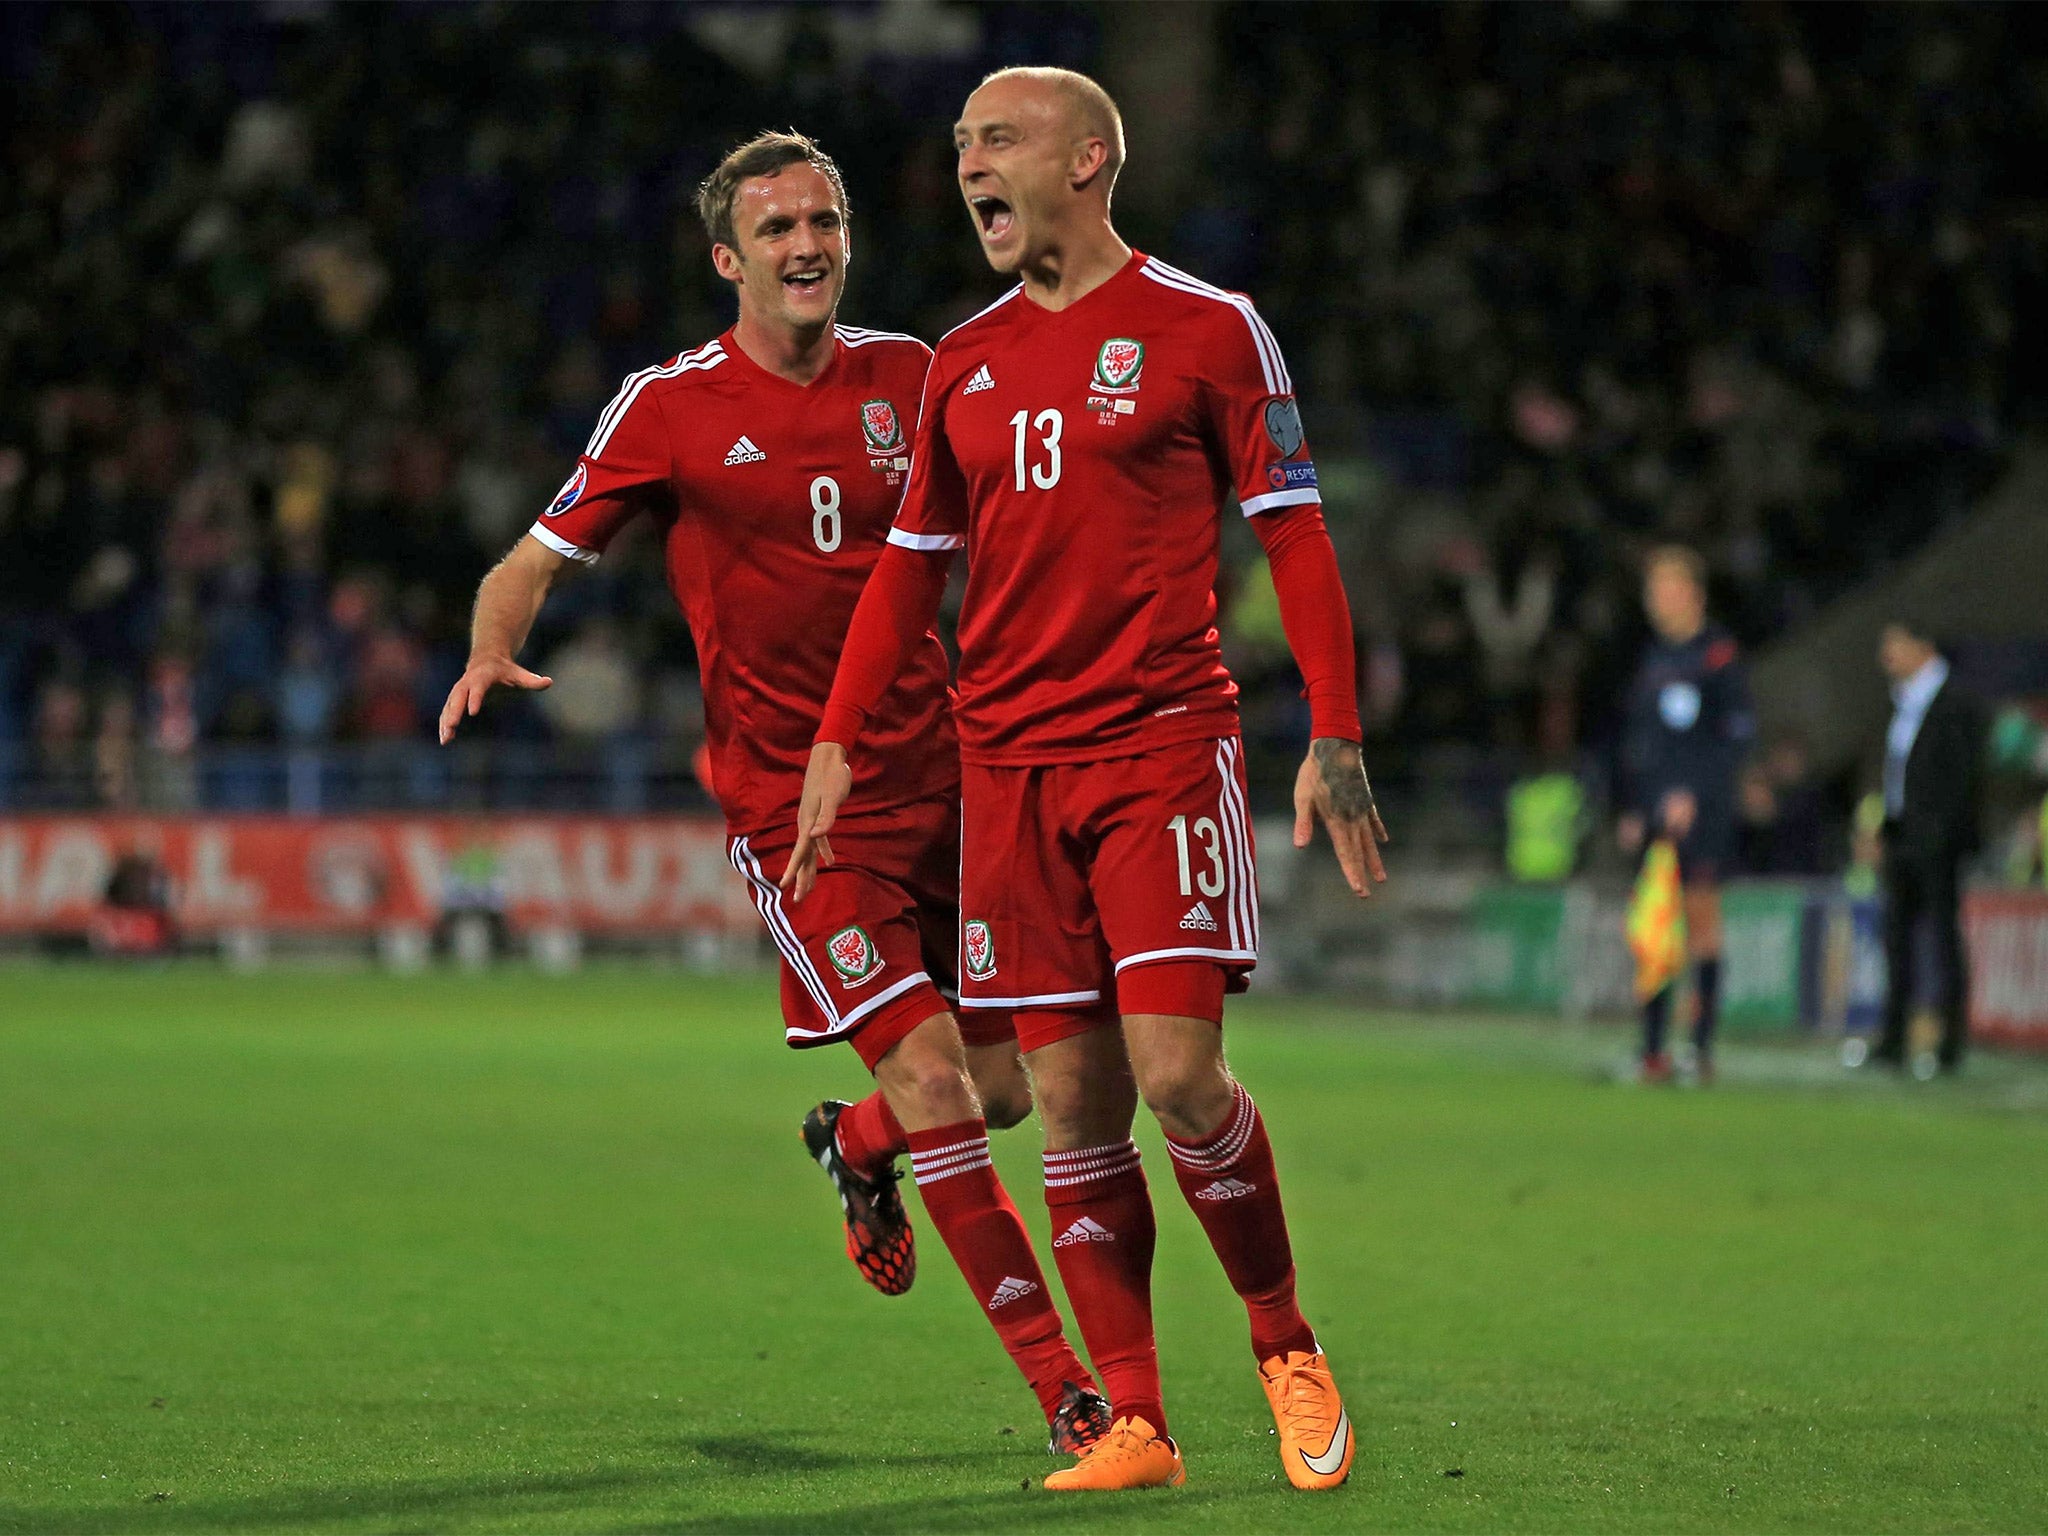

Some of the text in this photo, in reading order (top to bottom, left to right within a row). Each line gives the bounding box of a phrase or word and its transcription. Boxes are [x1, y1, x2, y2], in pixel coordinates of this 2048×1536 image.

[963, 379, 995, 396] adidas
[723, 450, 767, 466] adidas
[1008, 407, 1065, 492] 13
[809, 475, 842, 553] 8
[1166, 814, 1226, 898] 13
[1179, 917, 1218, 932] adidas
[1195, 1183, 1257, 1201] adidas
[1053, 1231, 1116, 1248] adidas
[988, 1281, 1039, 1310] adidas
